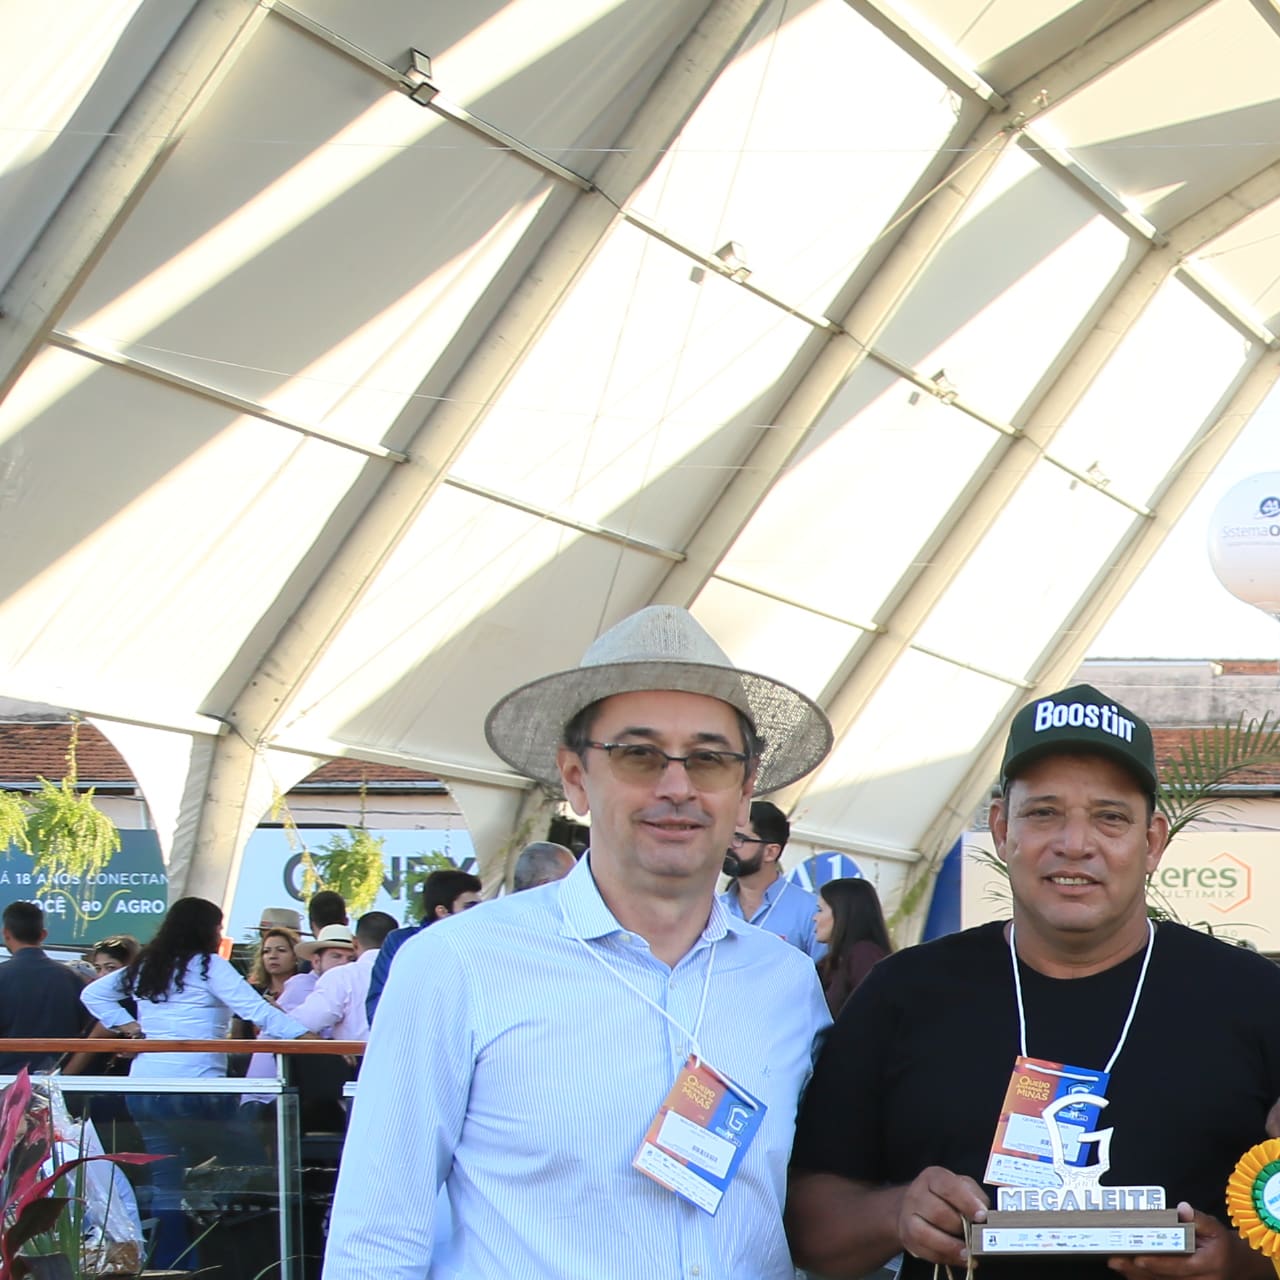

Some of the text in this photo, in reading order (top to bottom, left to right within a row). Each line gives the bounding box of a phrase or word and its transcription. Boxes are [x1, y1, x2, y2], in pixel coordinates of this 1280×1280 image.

[1034, 700, 1132, 743] Boostin
[15, 873, 32, 886] 18
[1148, 865, 1238, 889] eres
[81, 900, 103, 913] ao
[114, 899, 165, 914] AGRO
[1001, 1189, 1163, 1211] MEGALEITE
